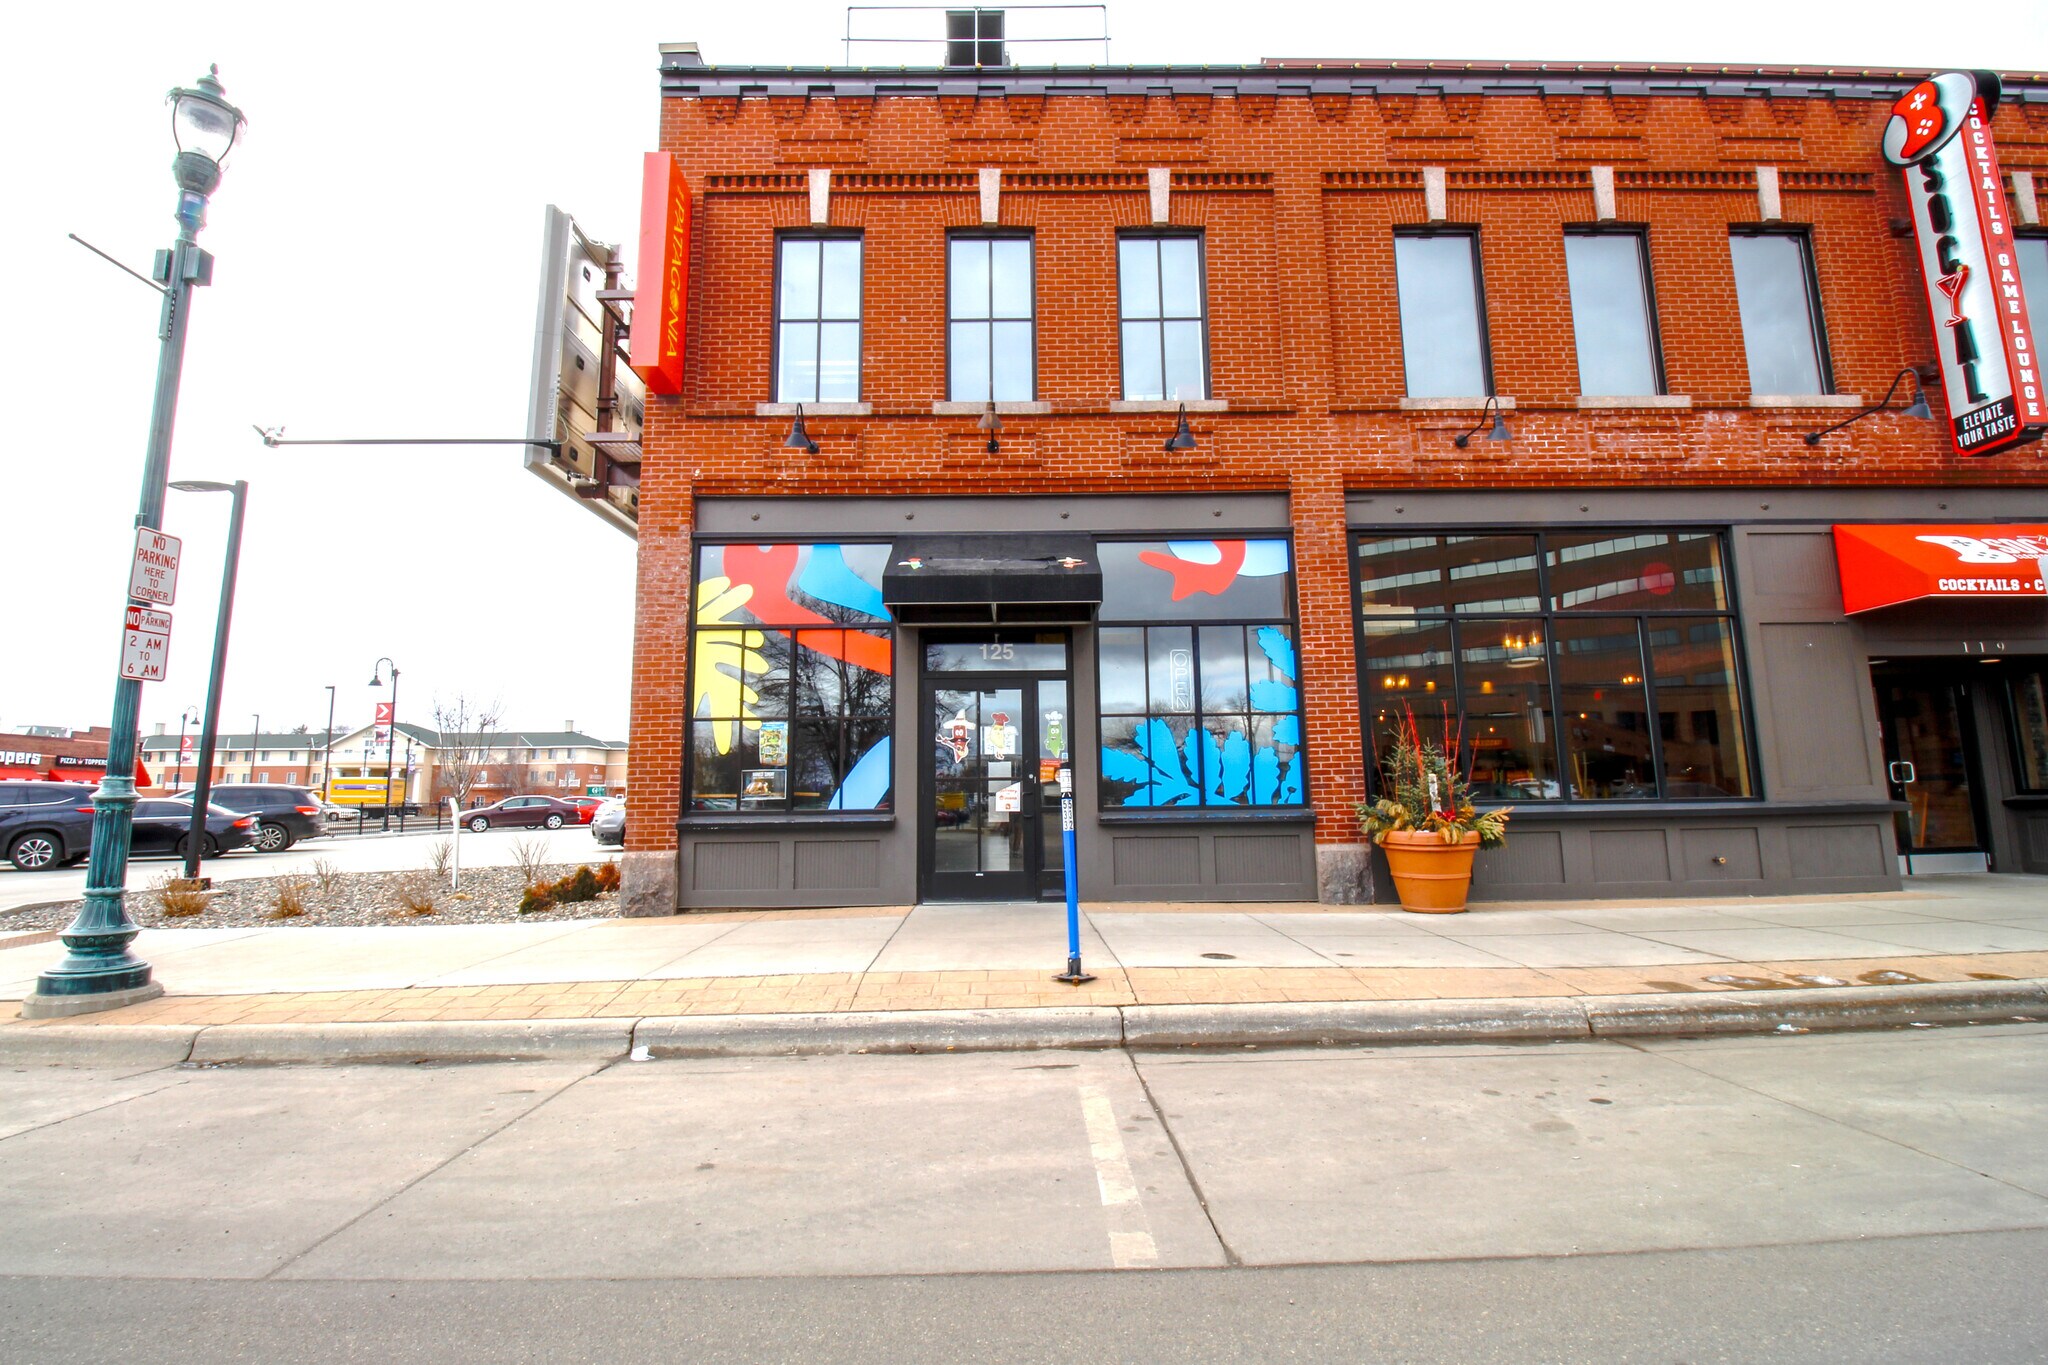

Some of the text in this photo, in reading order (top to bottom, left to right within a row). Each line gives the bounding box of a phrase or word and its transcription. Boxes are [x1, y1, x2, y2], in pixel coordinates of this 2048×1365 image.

[1969, 103, 2003, 235] COCKTAILS
[1998, 253, 2039, 416] GAME LOUNGE
[1963, 402, 2004, 430] ELEVATE
[1957, 415, 2016, 448] YOUR TASTE
[152, 536, 166, 550] NO
[137, 548, 176, 570] PARKING
[144, 567, 166, 580] HERE
[149, 578, 159, 588] TO
[1938, 578, 2020, 591] COCKTAILS
[136, 586, 169, 601] CORNER
[126, 610, 170, 629] NO PARKING
[130, 635, 162, 650] 2 AM
[139, 651, 150, 661] TO
[979, 643, 1014, 660] 125
[127, 663, 159, 677] 6 AM
[1173, 652, 1189, 709] OPEN
[60, 757, 77, 765] PIZZA
